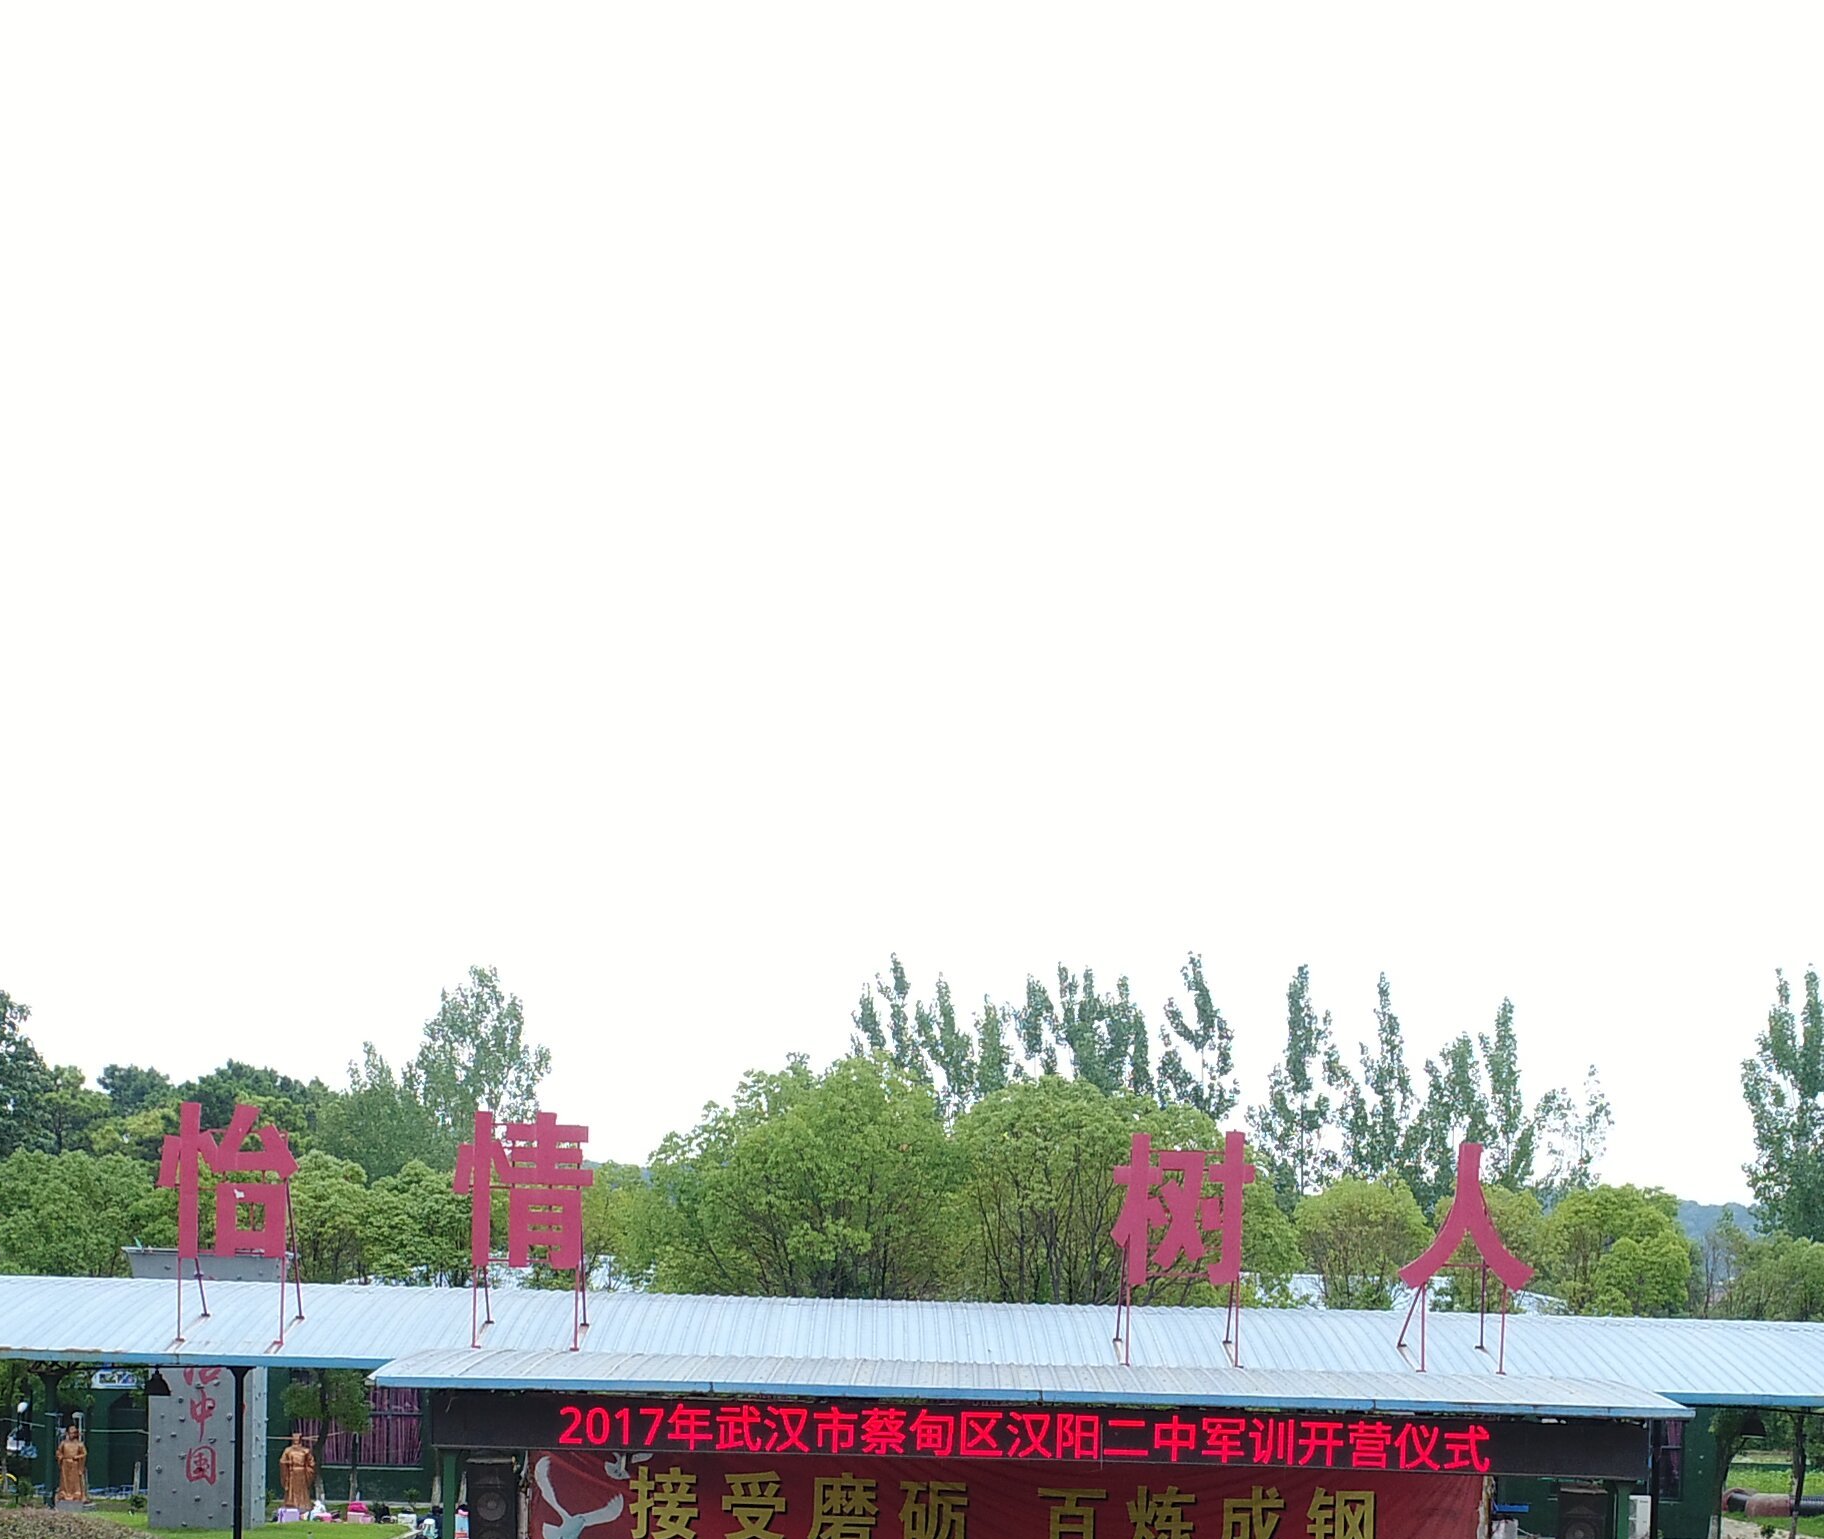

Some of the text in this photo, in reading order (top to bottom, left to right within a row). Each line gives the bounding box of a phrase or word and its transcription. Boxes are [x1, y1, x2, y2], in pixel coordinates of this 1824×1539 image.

[157, 1102, 594, 1269] 怡情
[1111, 1130, 1534, 1291] 树人
[558, 1405, 1490, 1473] 2017年武汉市蔡甸区汉阳二中军训开营仪式
